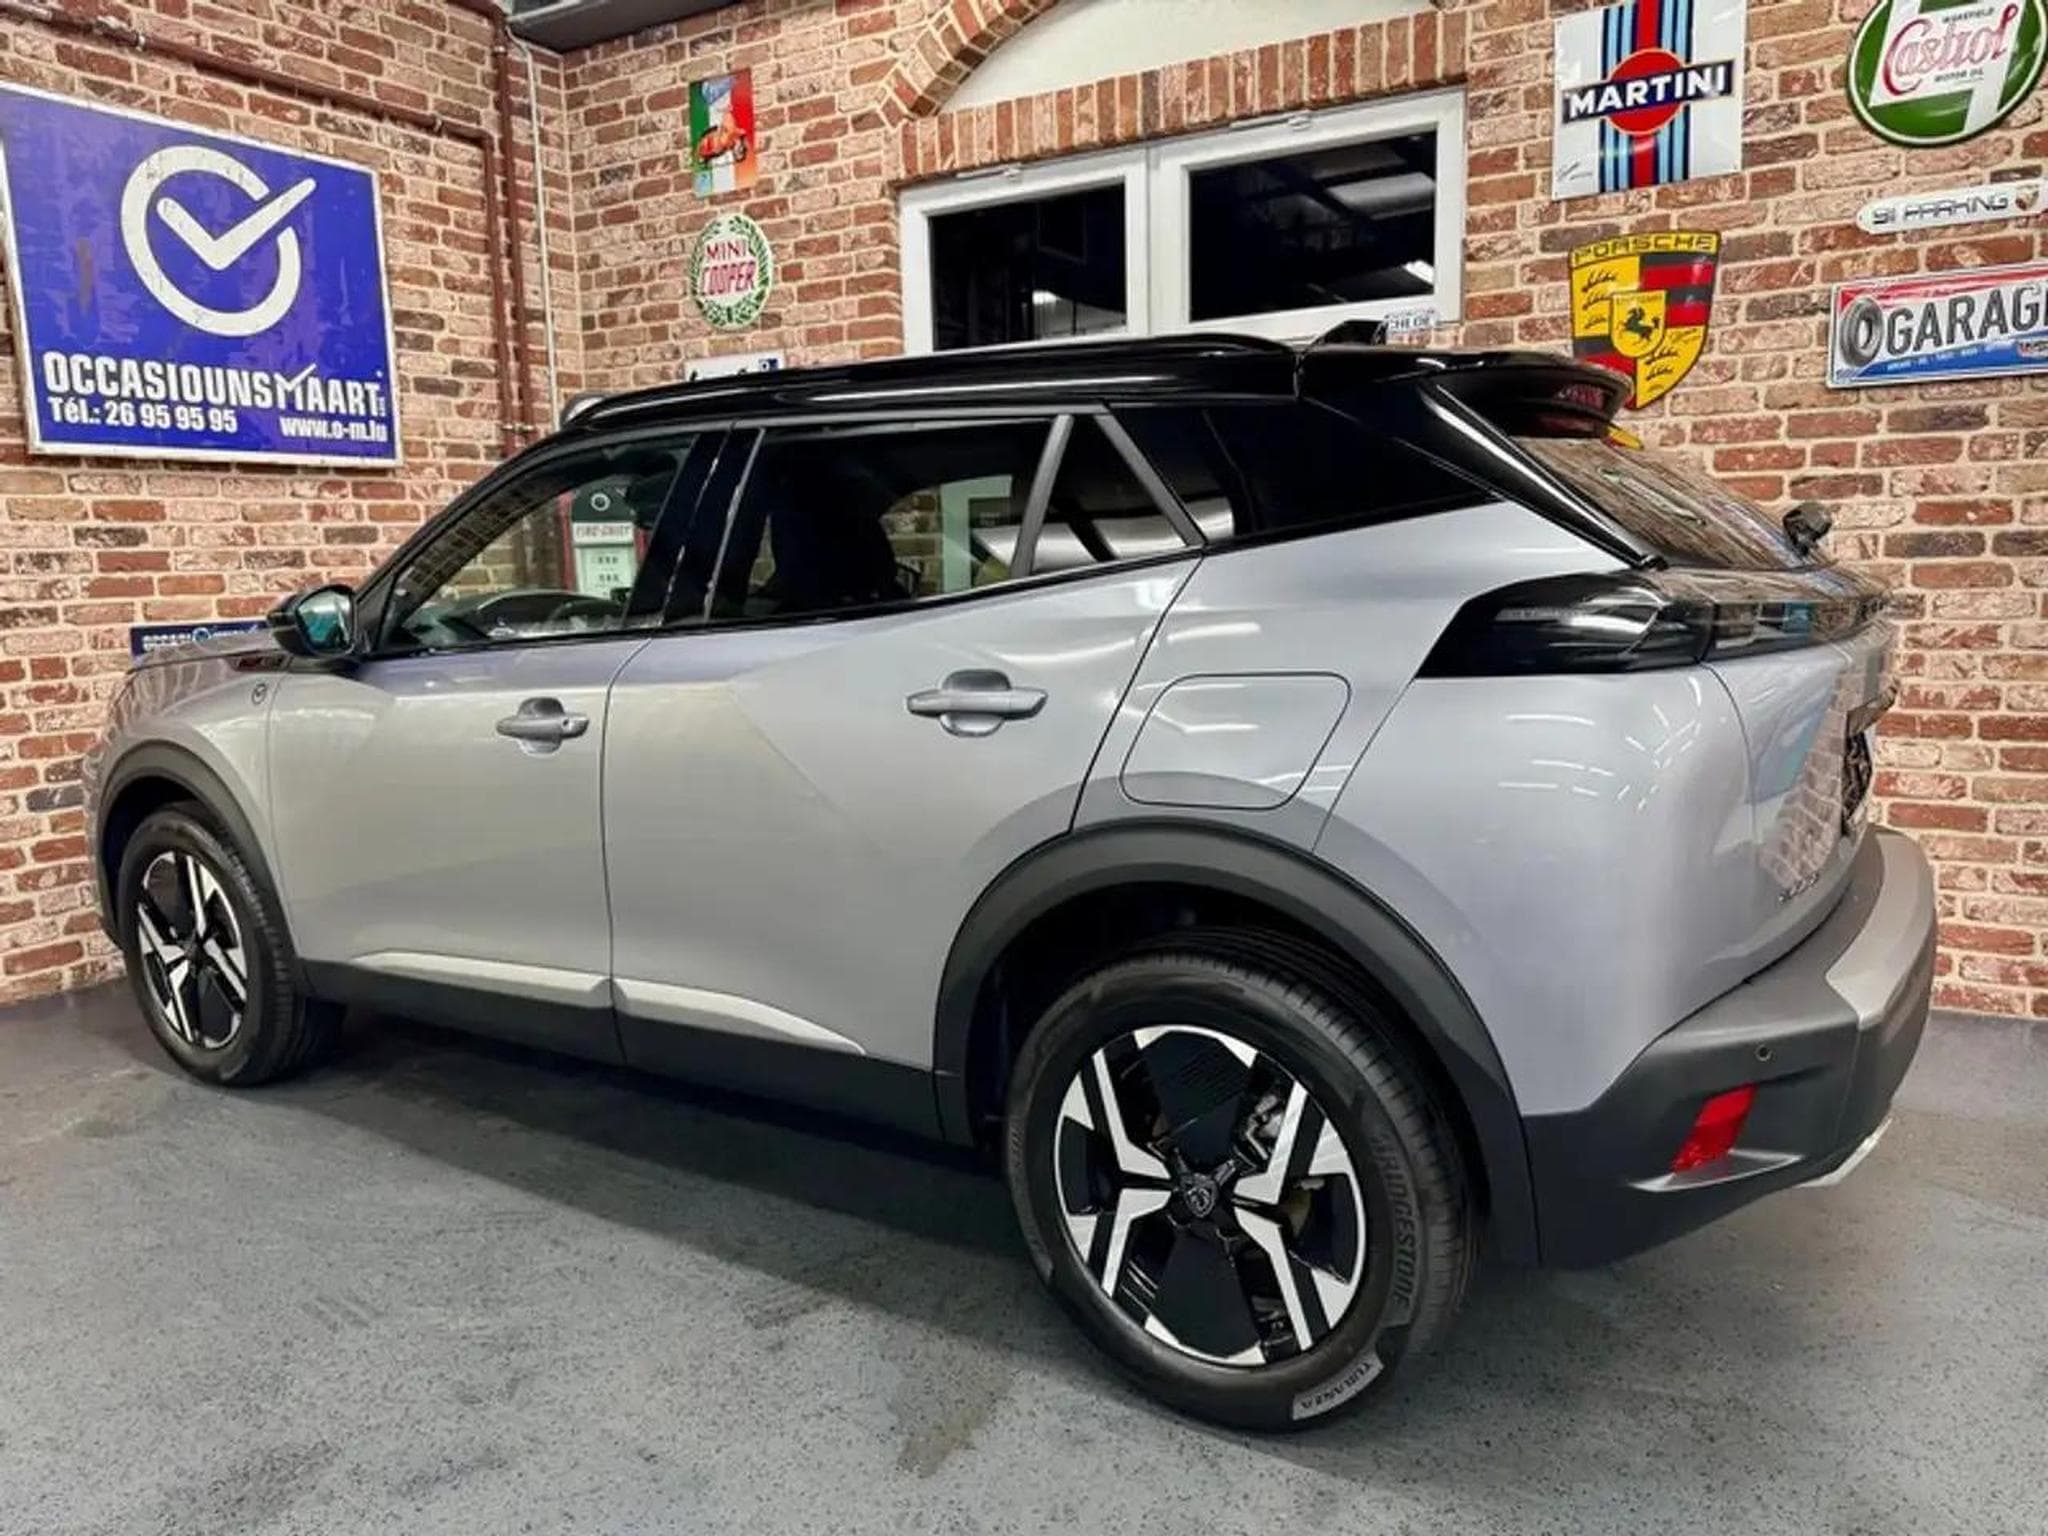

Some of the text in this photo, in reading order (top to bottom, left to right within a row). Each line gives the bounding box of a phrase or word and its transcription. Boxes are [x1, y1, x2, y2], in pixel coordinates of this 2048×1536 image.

[1883, 3, 2019, 97] Castrol
[1567, 65, 1726, 119] MARTINI
[1903, 194, 2009, 221] PARKING
[706, 240, 747, 260] MINI
[1574, 234, 1714, 264] PORSCHE
[702, 260, 757, 297] COOPER
[1886, 283, 2048, 356] GARAG
[104, 400, 136, 427] 26
[139, 402, 171, 430] 95
[174, 405, 205, 432] 95
[207, 407, 239, 435] 95
